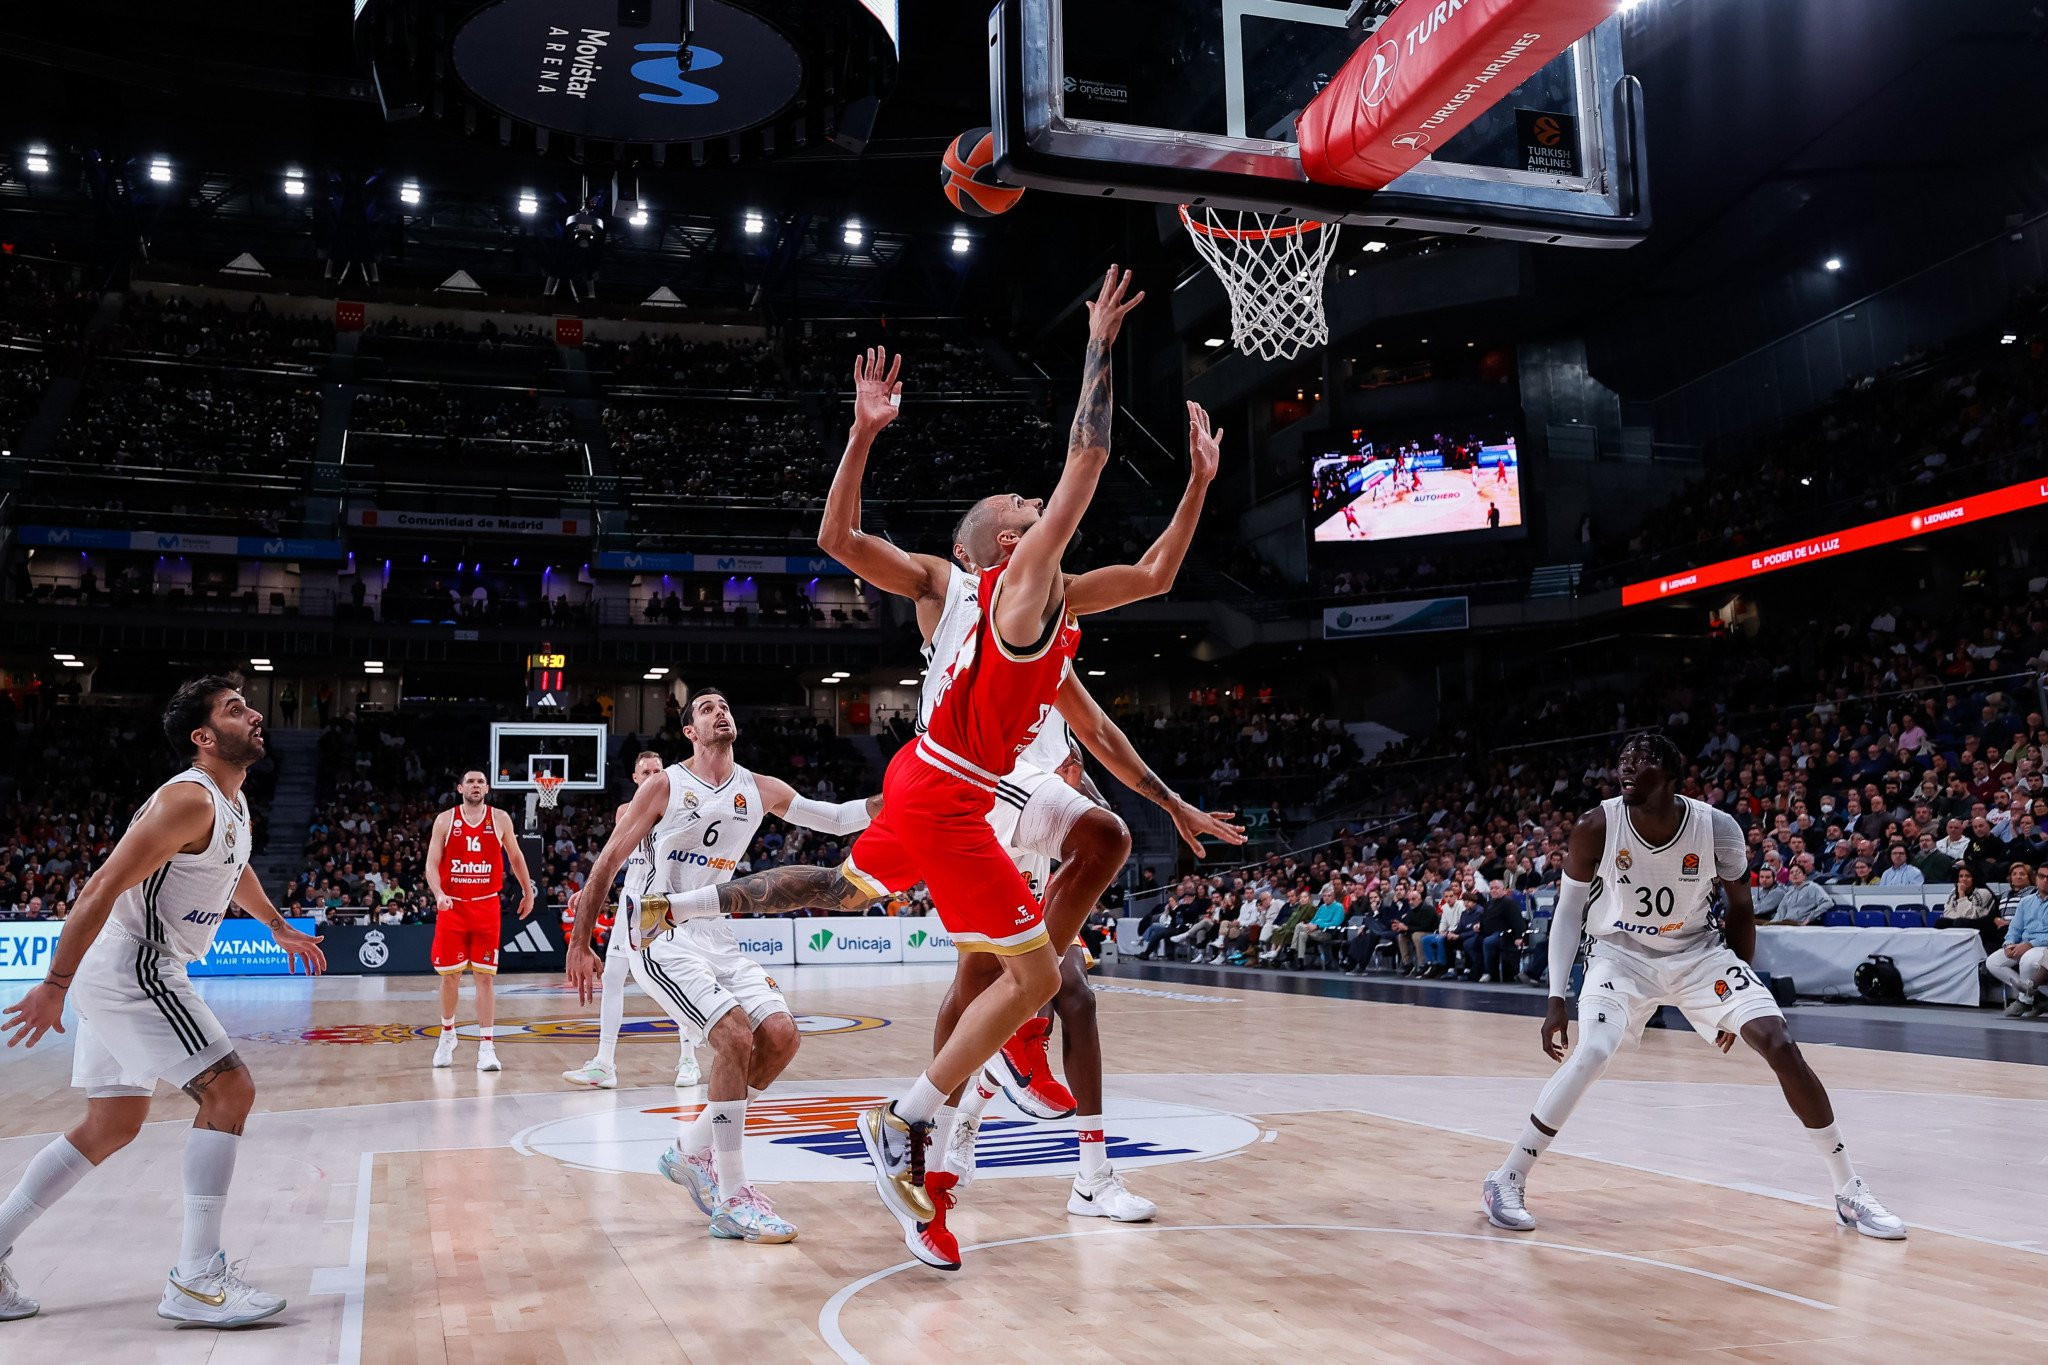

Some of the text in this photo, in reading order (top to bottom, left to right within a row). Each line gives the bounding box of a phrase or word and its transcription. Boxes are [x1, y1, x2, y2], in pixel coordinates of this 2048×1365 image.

[1406, 0, 1469, 56] TURK
[538, 26, 569, 92] ARENA
[566, 28, 610, 98] Movistar
[1419, 33, 1541, 129] TURKISH AIRLINES
[1080, 85, 1128, 98] oneteam
[1528, 146, 1571, 159] TURKISH
[1528, 156, 1572, 169] AIRLINES
[1413, 491, 1461, 502] AUTOHERO
[398, 514, 544, 530] Comunidad de Madrid
[1924, 507, 1964, 525] LEDVANCE
[1752, 538, 1840, 570] EL PODER DE LA LUZ
[539, 654, 566, 668] 4:30
[541, 671, 564, 691] 11
[703, 820, 722, 847] 6
[466, 836, 482, 852] 16
[667, 850, 737, 871] AUTOHERO
[1635, 886, 1675, 918] 30
[1613, 920, 1685, 936] AUTOHER
[211, 940, 288, 955] VATANM
[739, 938, 784, 955] nicaja
[837, 937, 891, 954] Unicaja
[929, 936, 956, 948] Unic
[0, 936, 60, 967] EXP
[216, 956, 298, 966] HAIR TRANSPLAT
